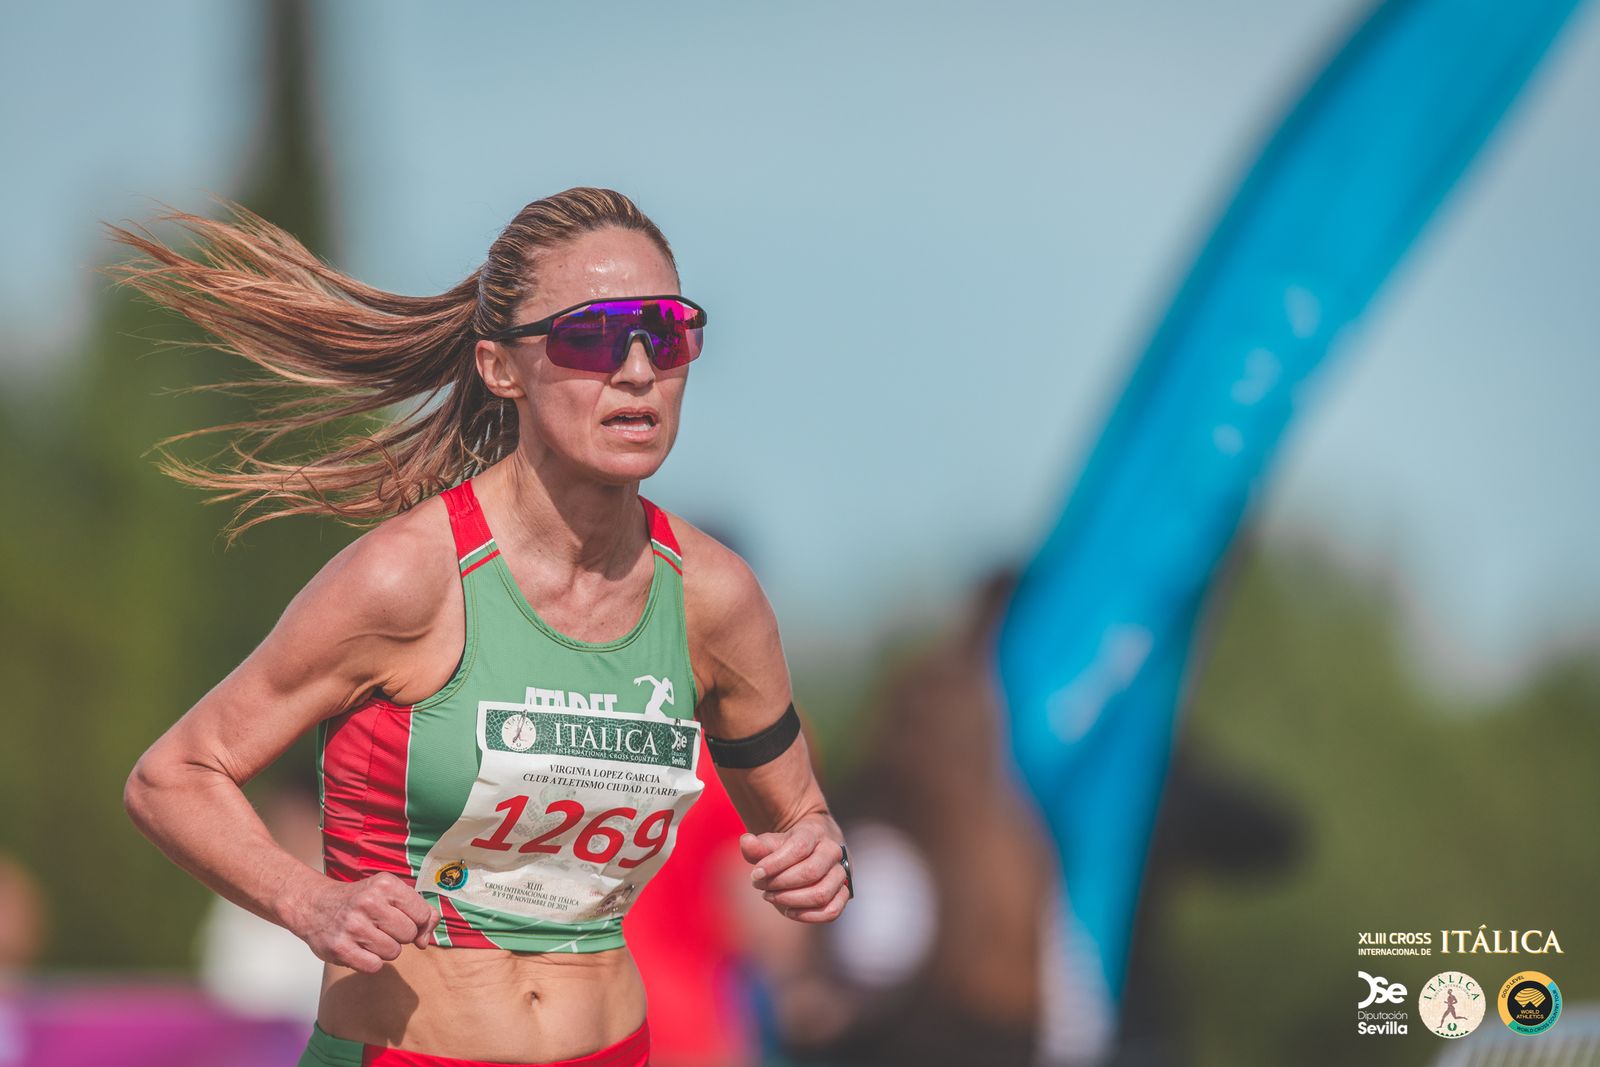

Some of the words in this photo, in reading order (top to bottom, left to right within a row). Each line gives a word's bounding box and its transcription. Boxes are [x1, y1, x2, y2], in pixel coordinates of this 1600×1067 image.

[554, 720, 659, 756] ITÁLICA
[556, 747, 607, 758] INTERNATIONAL
[610, 753, 630, 761] CROSS
[631, 755, 659, 763] COUNTRY
[550, 764, 591, 777] VIRGINIA
[593, 767, 623, 780] LOPEZ
[625, 772, 660, 784] GARCIA
[523, 773, 548, 783] CLUB
[550, 777, 604, 789] ATLETISMO
[606, 782, 641, 793] CIUDAD
[643, 787, 678, 797] ATARFE
[470, 795, 675, 869] 1269
[485, 882, 503, 891] CROSS
[504, 885, 547, 900] INTERNACIONAL
[515, 896, 546, 907] NOVIEMBRE
